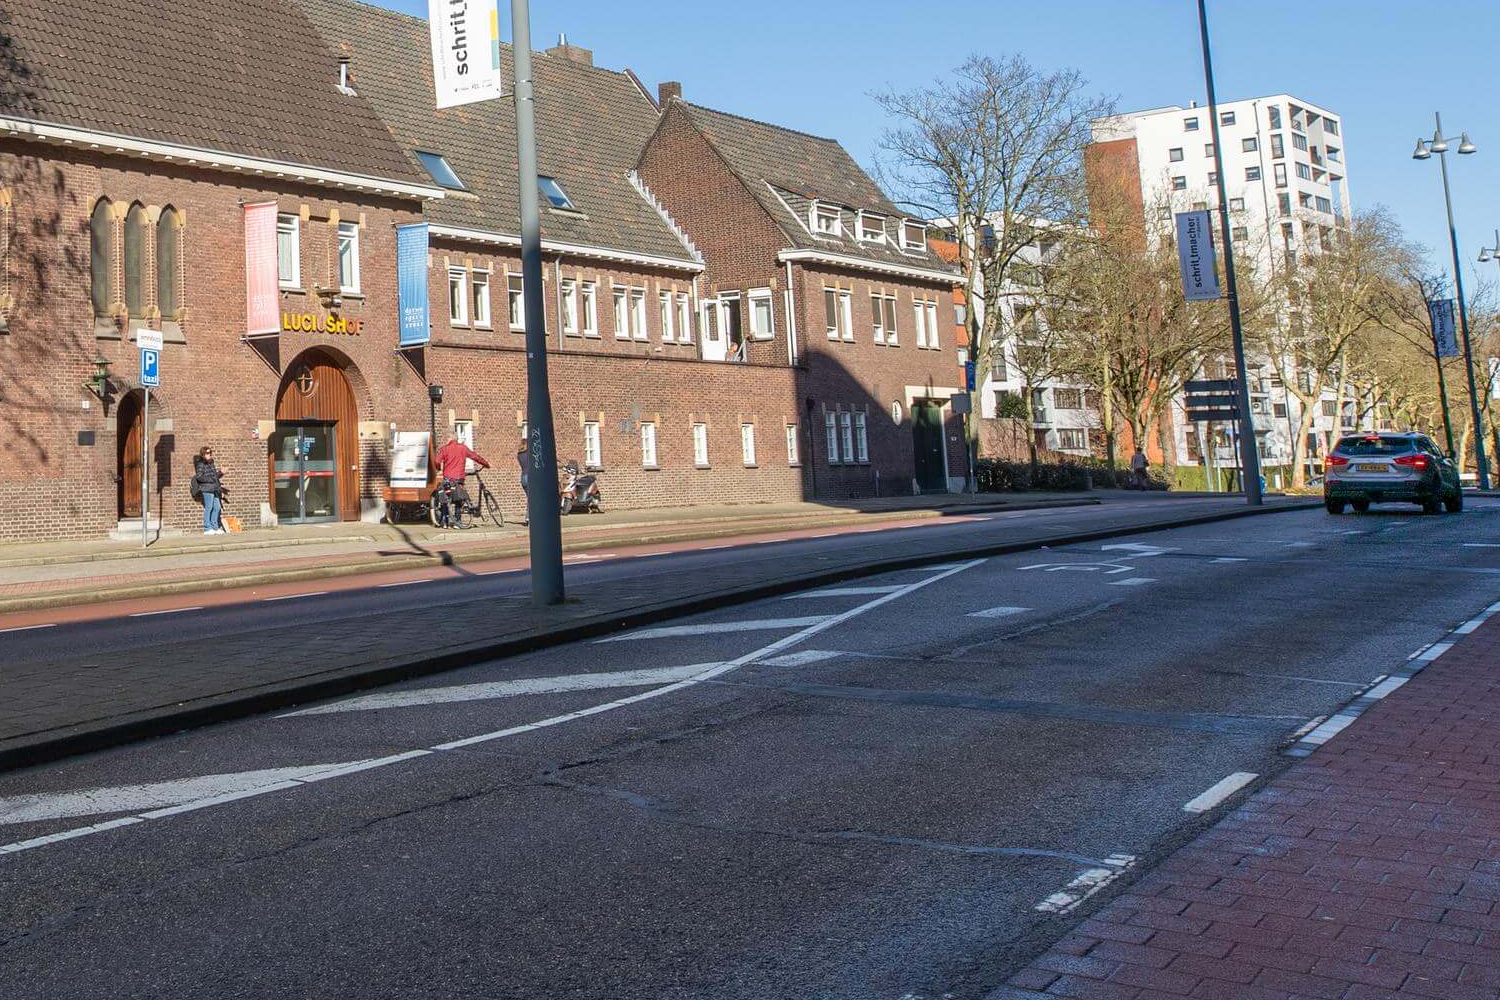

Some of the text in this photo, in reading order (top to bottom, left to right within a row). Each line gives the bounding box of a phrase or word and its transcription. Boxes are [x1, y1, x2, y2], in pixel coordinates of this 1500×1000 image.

[283, 312, 365, 336] LUCIUSHOF
[145, 352, 155, 370] P
[144, 374, 157, 383] taxi
